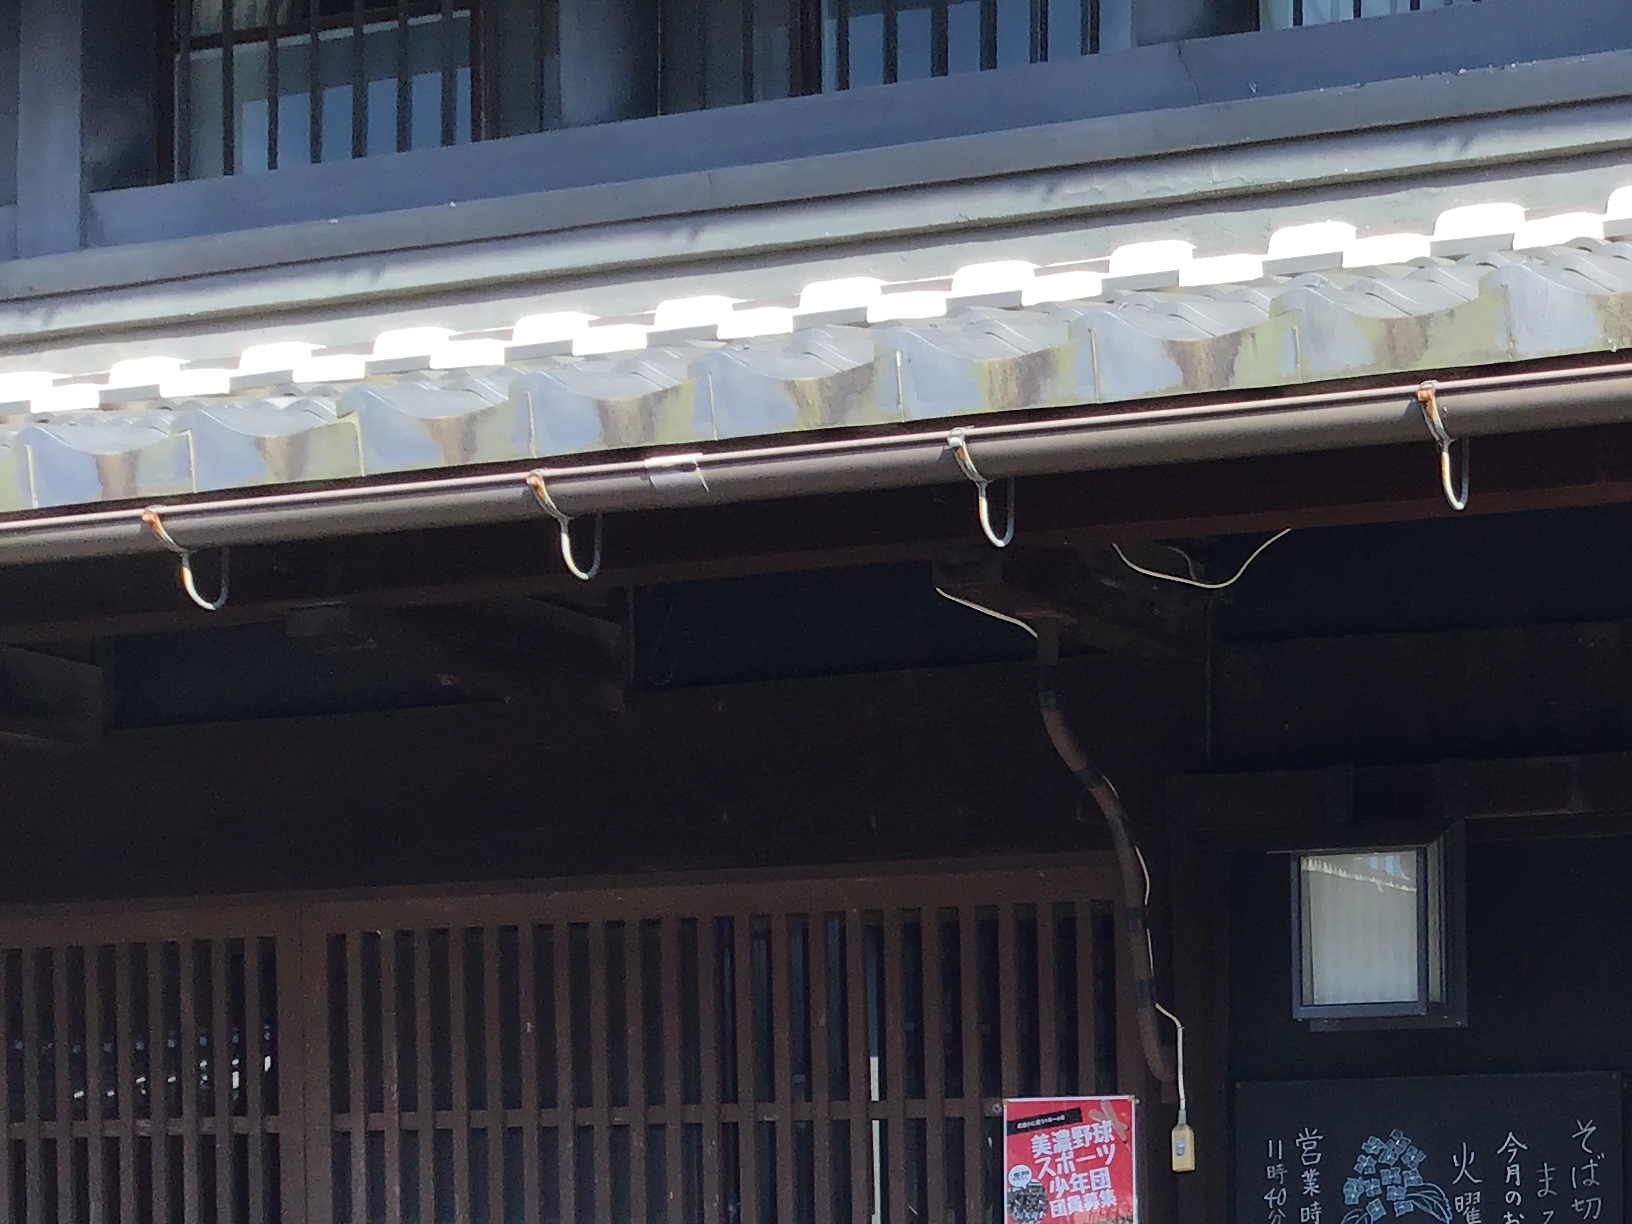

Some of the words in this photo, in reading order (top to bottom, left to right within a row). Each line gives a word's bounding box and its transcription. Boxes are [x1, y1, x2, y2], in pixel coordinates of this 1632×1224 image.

[1031, 1120, 1115, 1158] 美濃野球
[1035, 1144, 1116, 1179] スポーツ
[1049, 1167, 1111, 1198] 少年団
[1049, 1188, 1117, 1218] 団員募集
